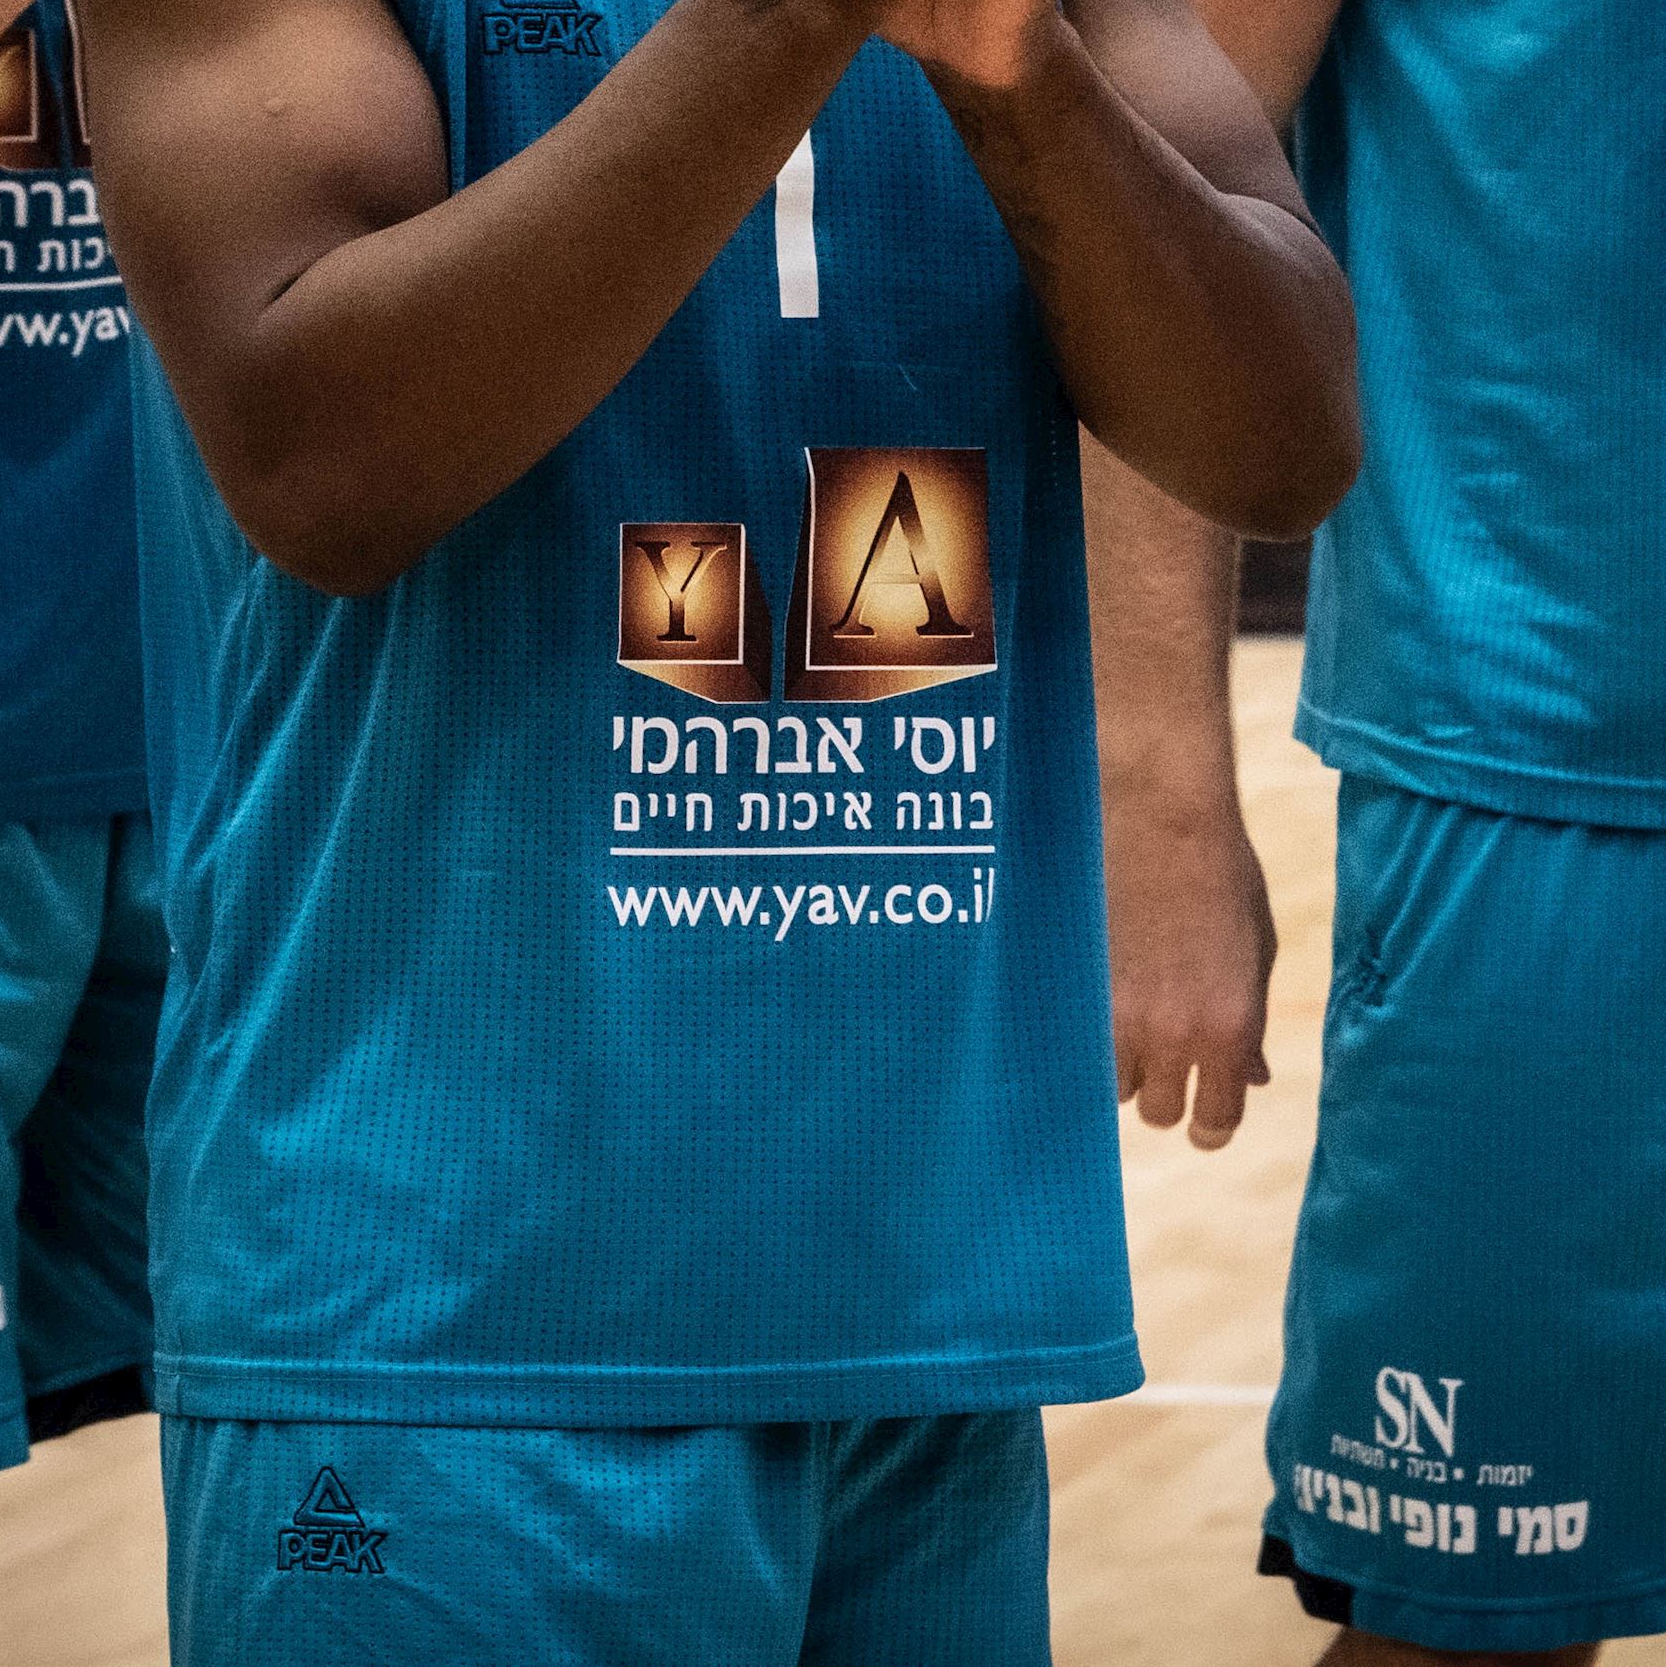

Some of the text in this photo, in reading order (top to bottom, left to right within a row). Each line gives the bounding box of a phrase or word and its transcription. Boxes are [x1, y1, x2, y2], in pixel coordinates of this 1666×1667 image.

[483, 12, 602, 57] PEAK
[833, 470, 976, 639] A
[612, 715, 997, 776] יוסי אברהמי
[613, 790, 995, 833] בונה איכות חיים
[606, 866, 996, 942] www.yav.co.il
[1374, 1365, 1466, 1460] SN
[277, 1528, 389, 1575] PEAK
[1388, 1493, 1477, 1555] נופי
[1497, 1499, 1590, 1556] סמי
